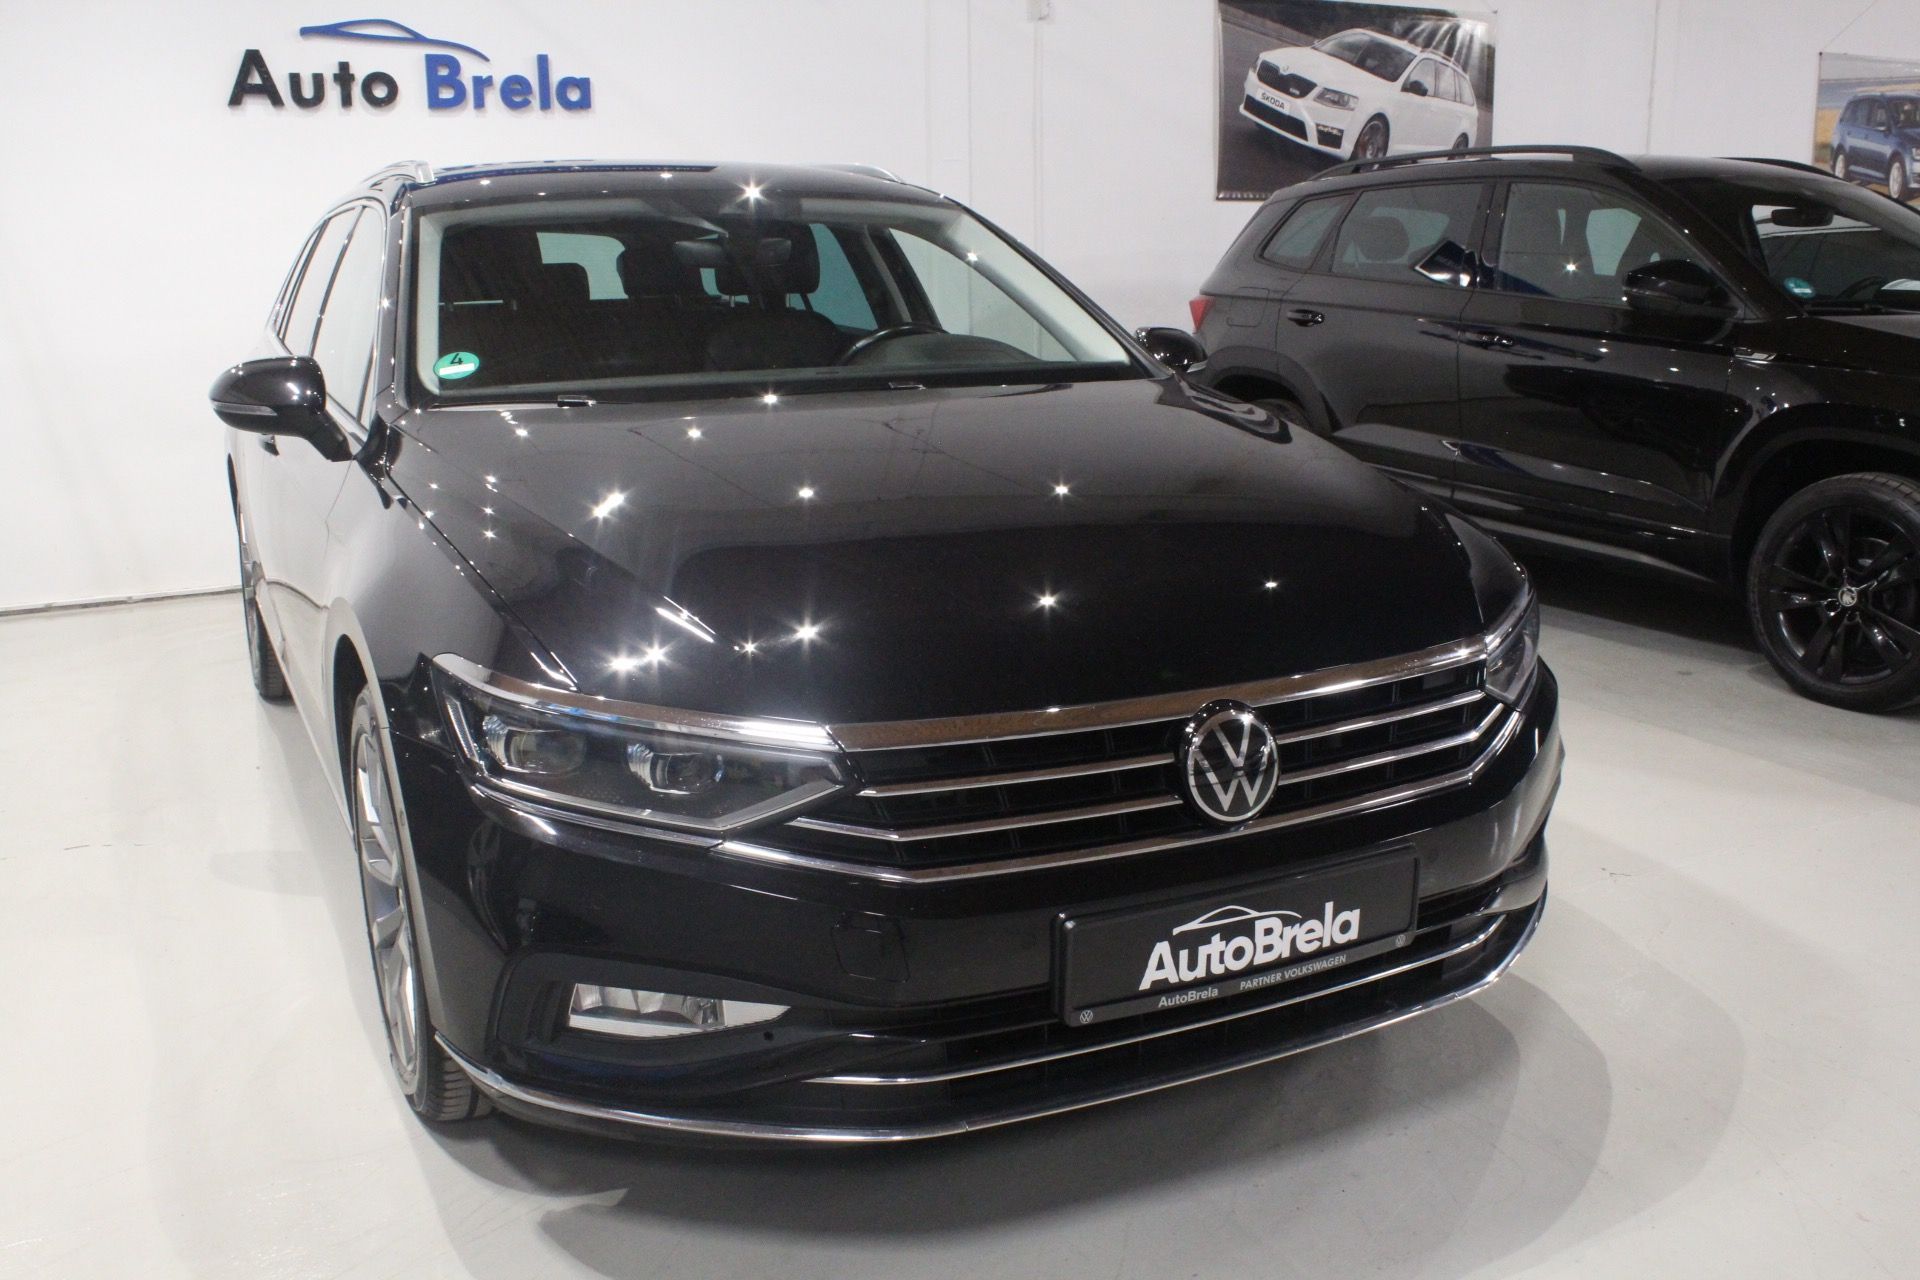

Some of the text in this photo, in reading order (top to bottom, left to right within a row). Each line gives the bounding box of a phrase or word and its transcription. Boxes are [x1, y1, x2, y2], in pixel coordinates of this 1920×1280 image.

[228, 49, 592, 111] Auto Brela
[451, 353, 463, 365] 4
[1139, 902, 1360, 990] AutoBrela
[1240, 954, 1347, 990] PARTNER VOLKSWAGEN
[1158, 988, 1219, 1009] AutoBrela
